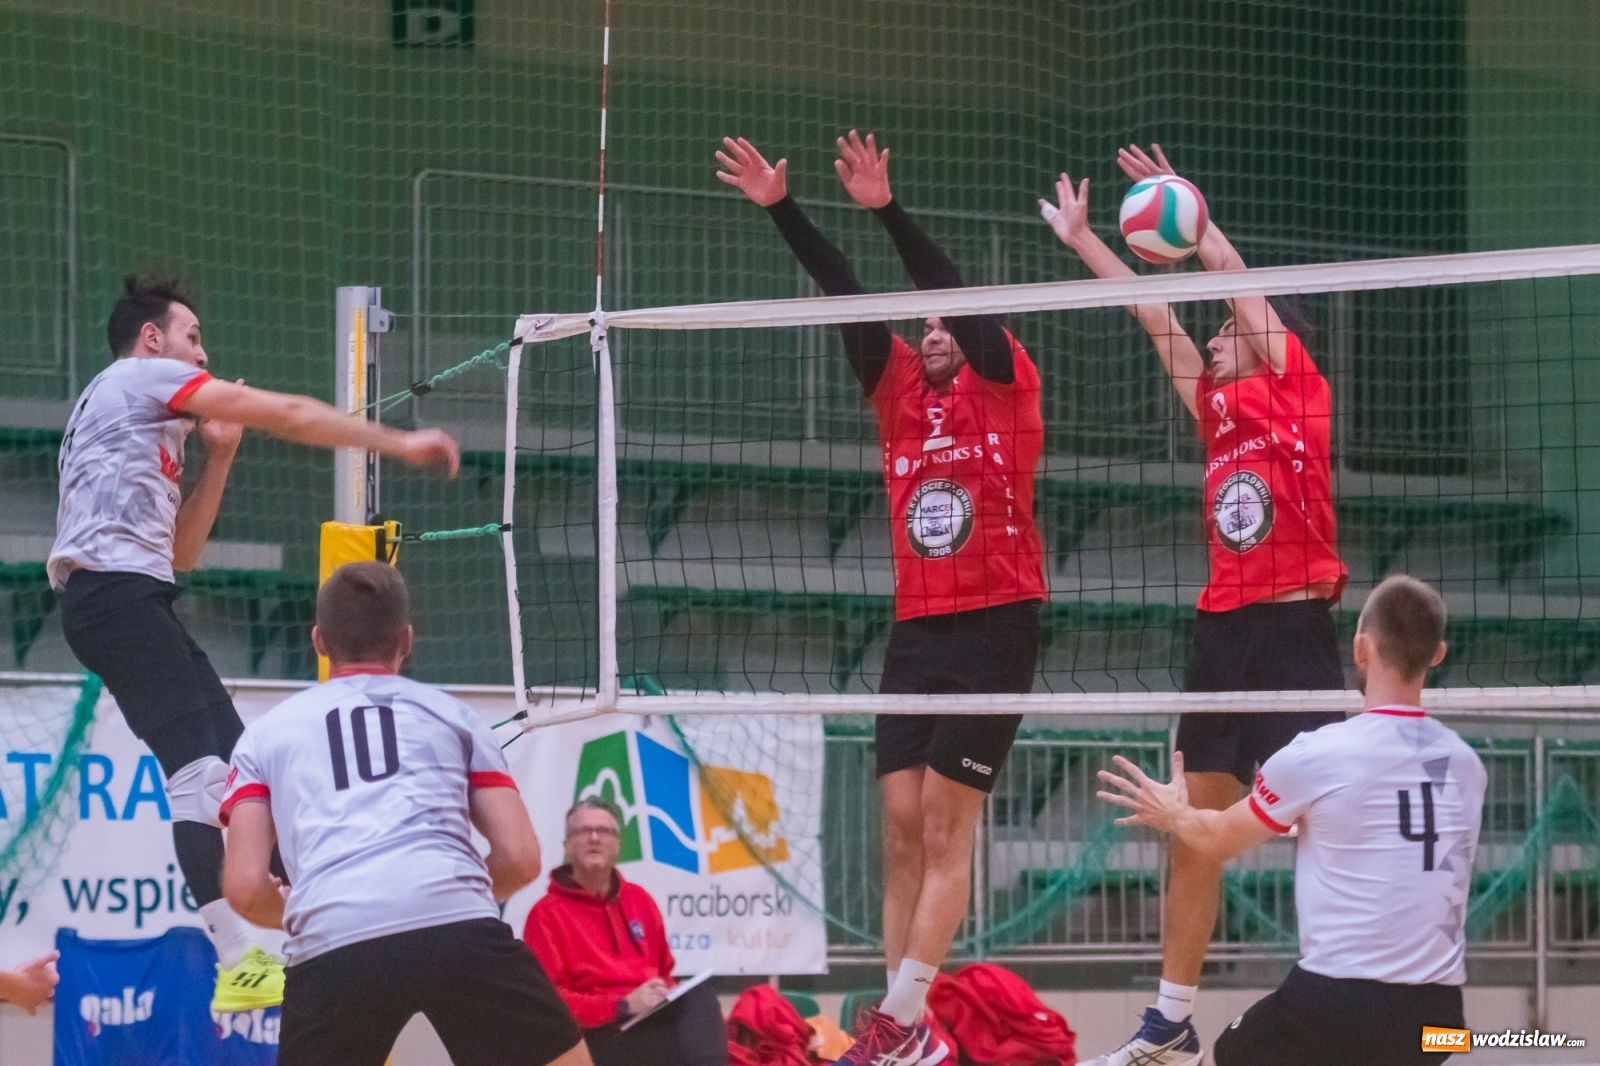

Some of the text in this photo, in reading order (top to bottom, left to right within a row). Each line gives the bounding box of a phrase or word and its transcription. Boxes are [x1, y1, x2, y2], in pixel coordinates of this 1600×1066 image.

[923, 408, 956, 452] 2
[932, 447, 971, 465] KOKS
[987, 432, 1018, 537] RALIN
[325, 705, 400, 791] 10
[79, 753, 171, 821] RA
[1397, 781, 1439, 872] 4
[666, 884, 793, 917] raciborski
